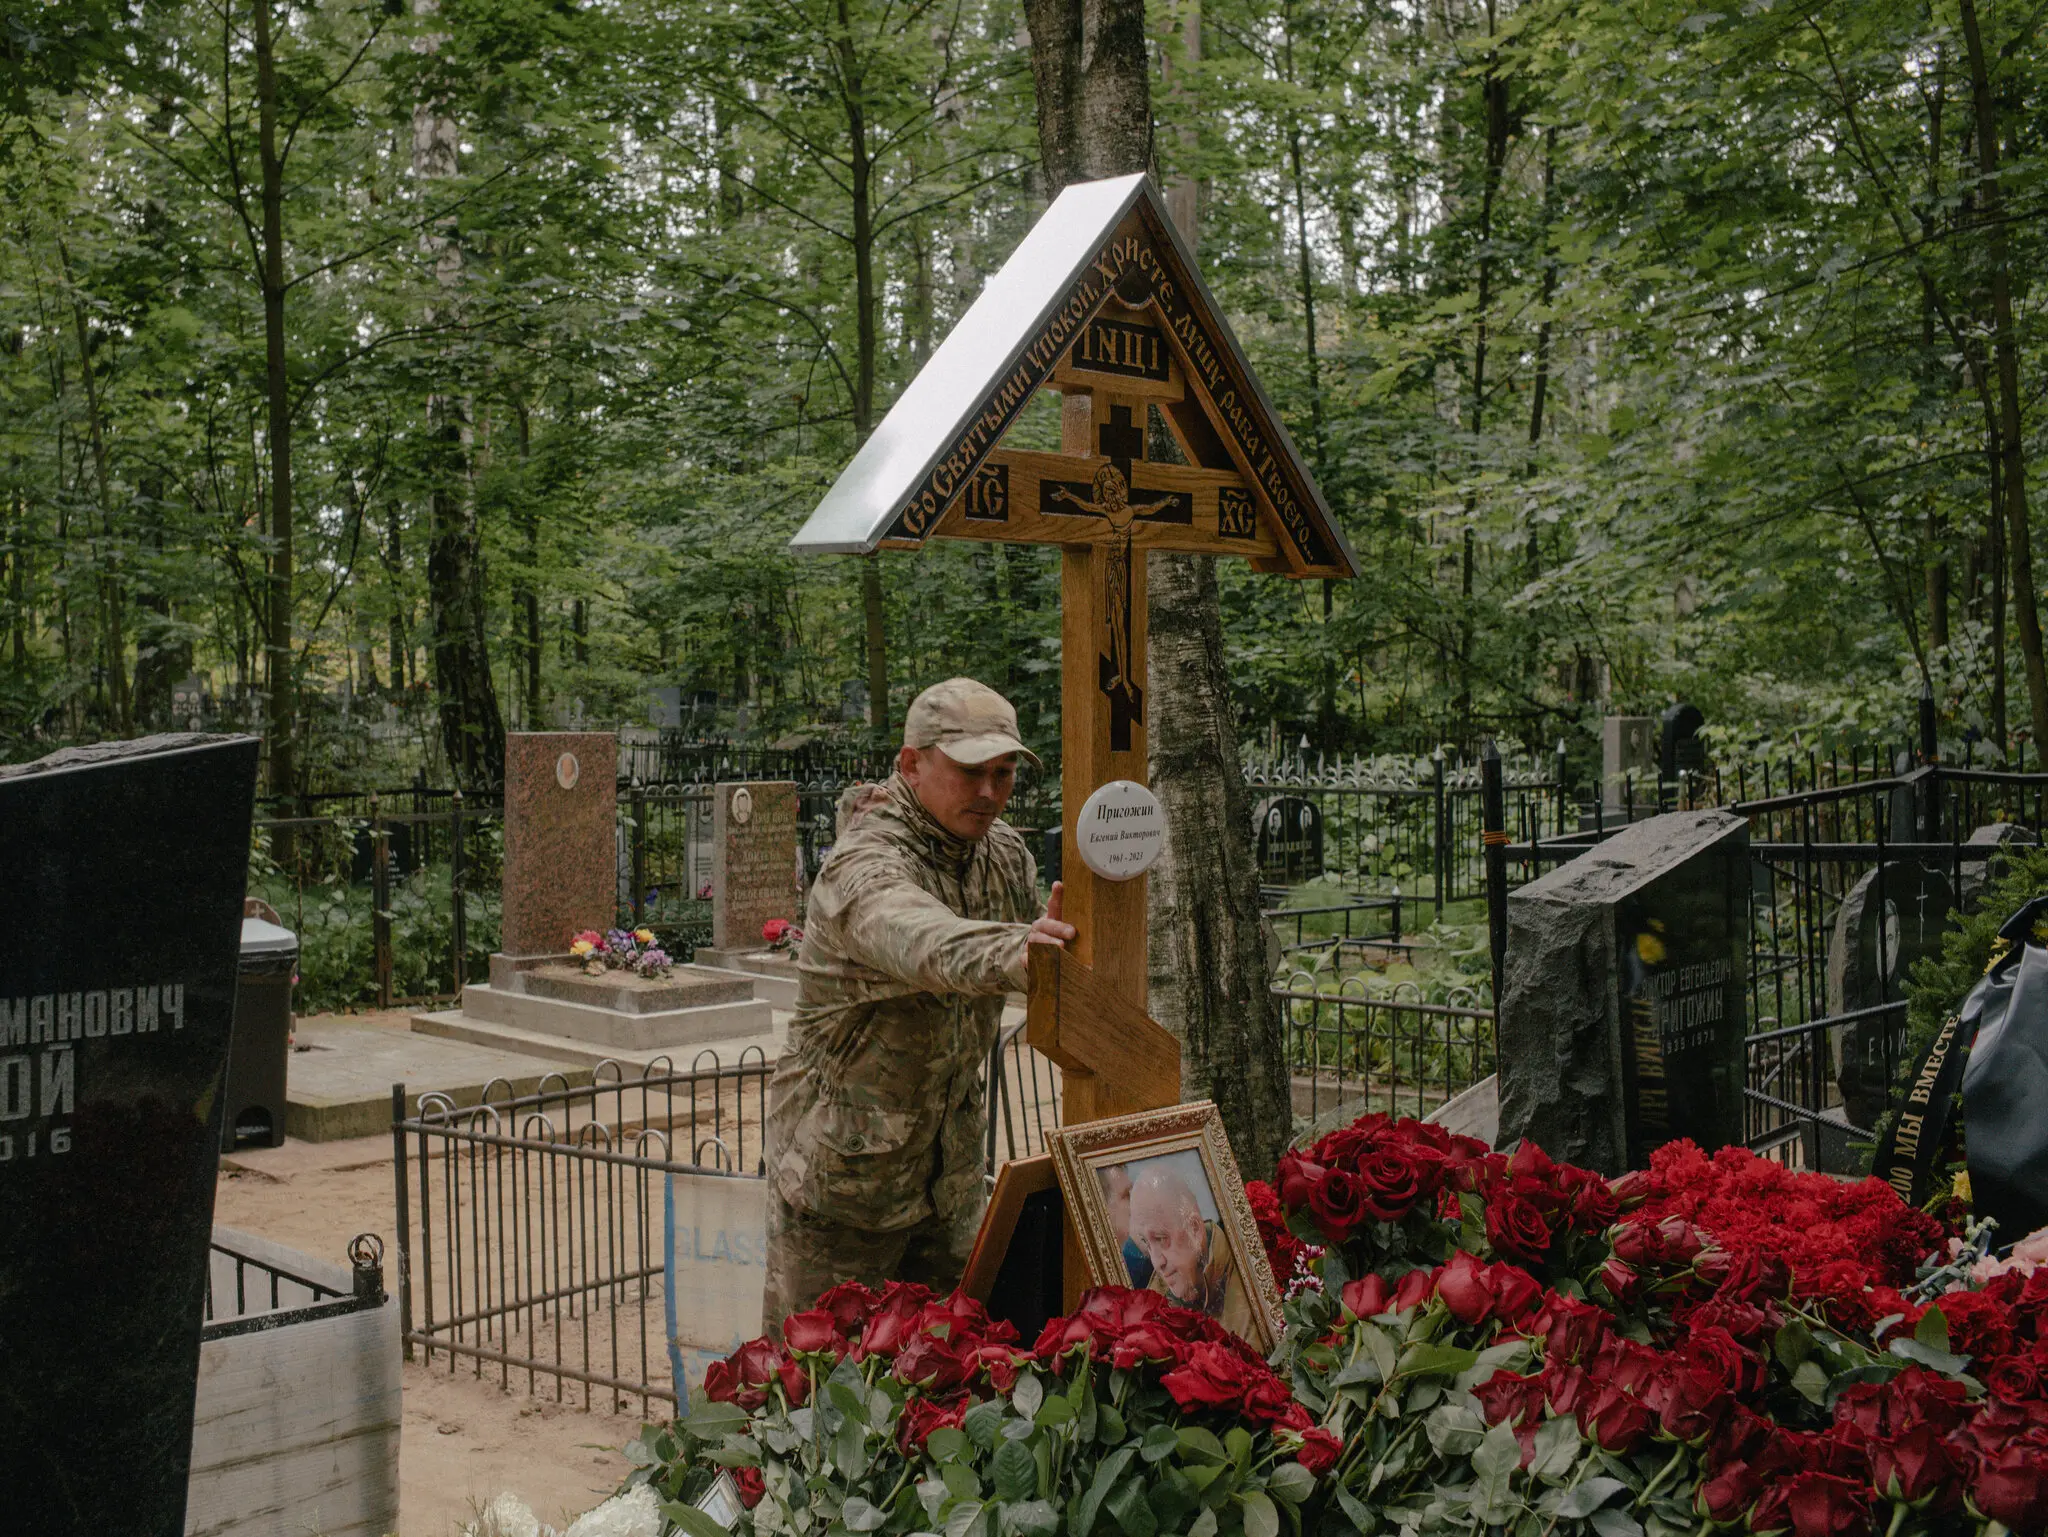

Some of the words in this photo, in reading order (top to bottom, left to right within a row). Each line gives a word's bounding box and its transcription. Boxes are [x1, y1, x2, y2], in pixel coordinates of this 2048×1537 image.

[1097, 804, 1154, 823] Пригожин
[1090, 831, 1119, 843] Евгений
[1120, 829, 1161, 841] Викторович
[1109, 853, 1123, 864] 1961
[1129, 852, 1144, 862] 2023
[1908, 1013, 1961, 1106] ВМЕСТЕ
[1894, 1111, 1925, 1161] МЫ
